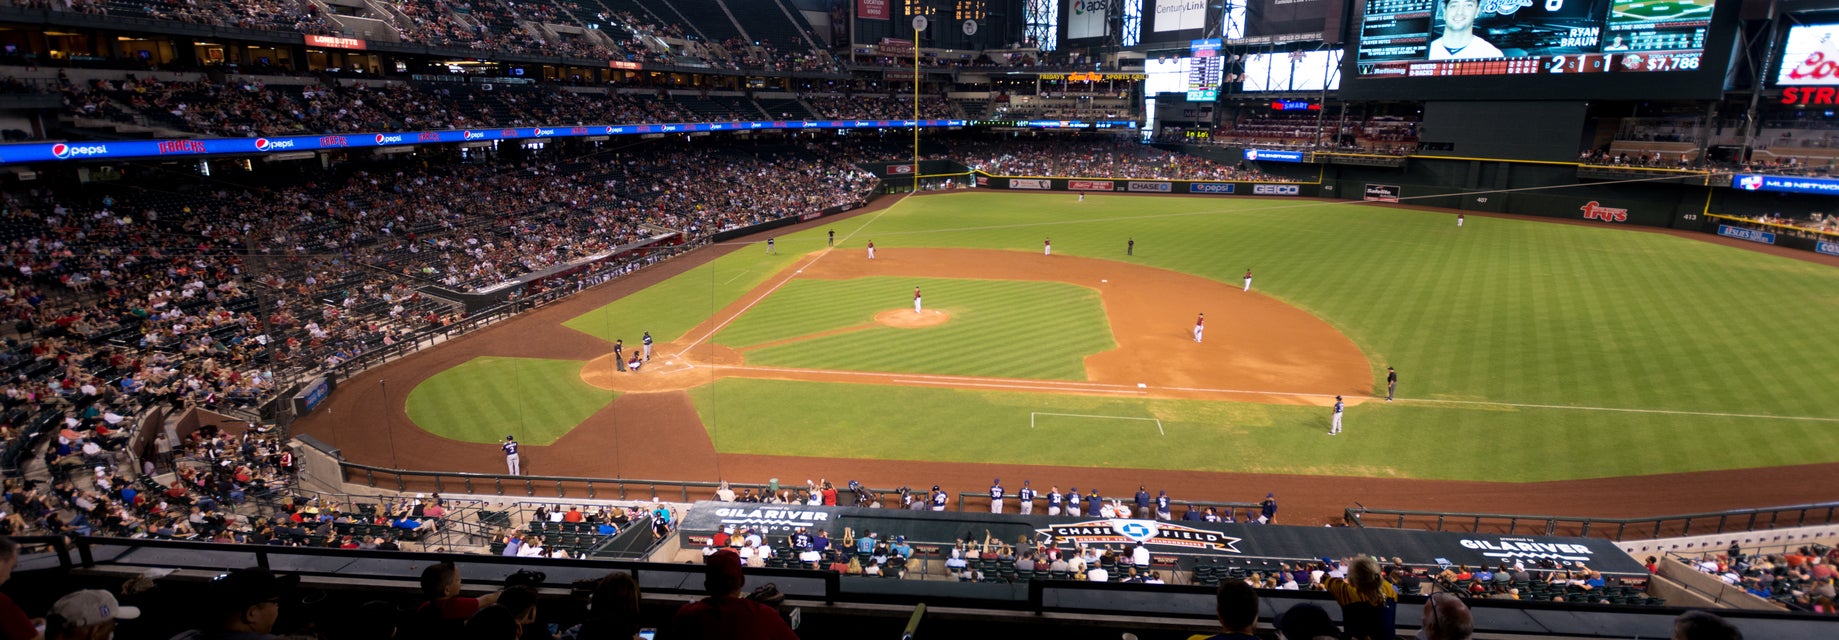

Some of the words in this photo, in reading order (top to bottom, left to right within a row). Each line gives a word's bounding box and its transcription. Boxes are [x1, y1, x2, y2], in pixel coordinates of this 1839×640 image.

[1087, 0, 1106, 13] aps
[1156, 2, 1205, 14] CenturyLink
[1570, 27, 1599, 37] RYAN
[1560, 37, 1597, 47] BRAUN
[1549, 55, 1566, 73] 2
[1569, 61, 1575, 69] S
[1577, 54, 1586, 73] 1
[1603, 53, 1612, 72] 1
[1647, 57, 1700, 71] $7,786
[385, 135, 402, 143] pepsi
[470, 131, 484, 139] pepsi
[270, 140, 294, 149] pepsi
[71, 145, 107, 156] pepsi
[1205, 184, 1229, 193] pepsi
[1254, 185, 1299, 194] GEICO
[1058, 526, 1112, 536] CHASE
[1162, 530, 1218, 541] FIELD
